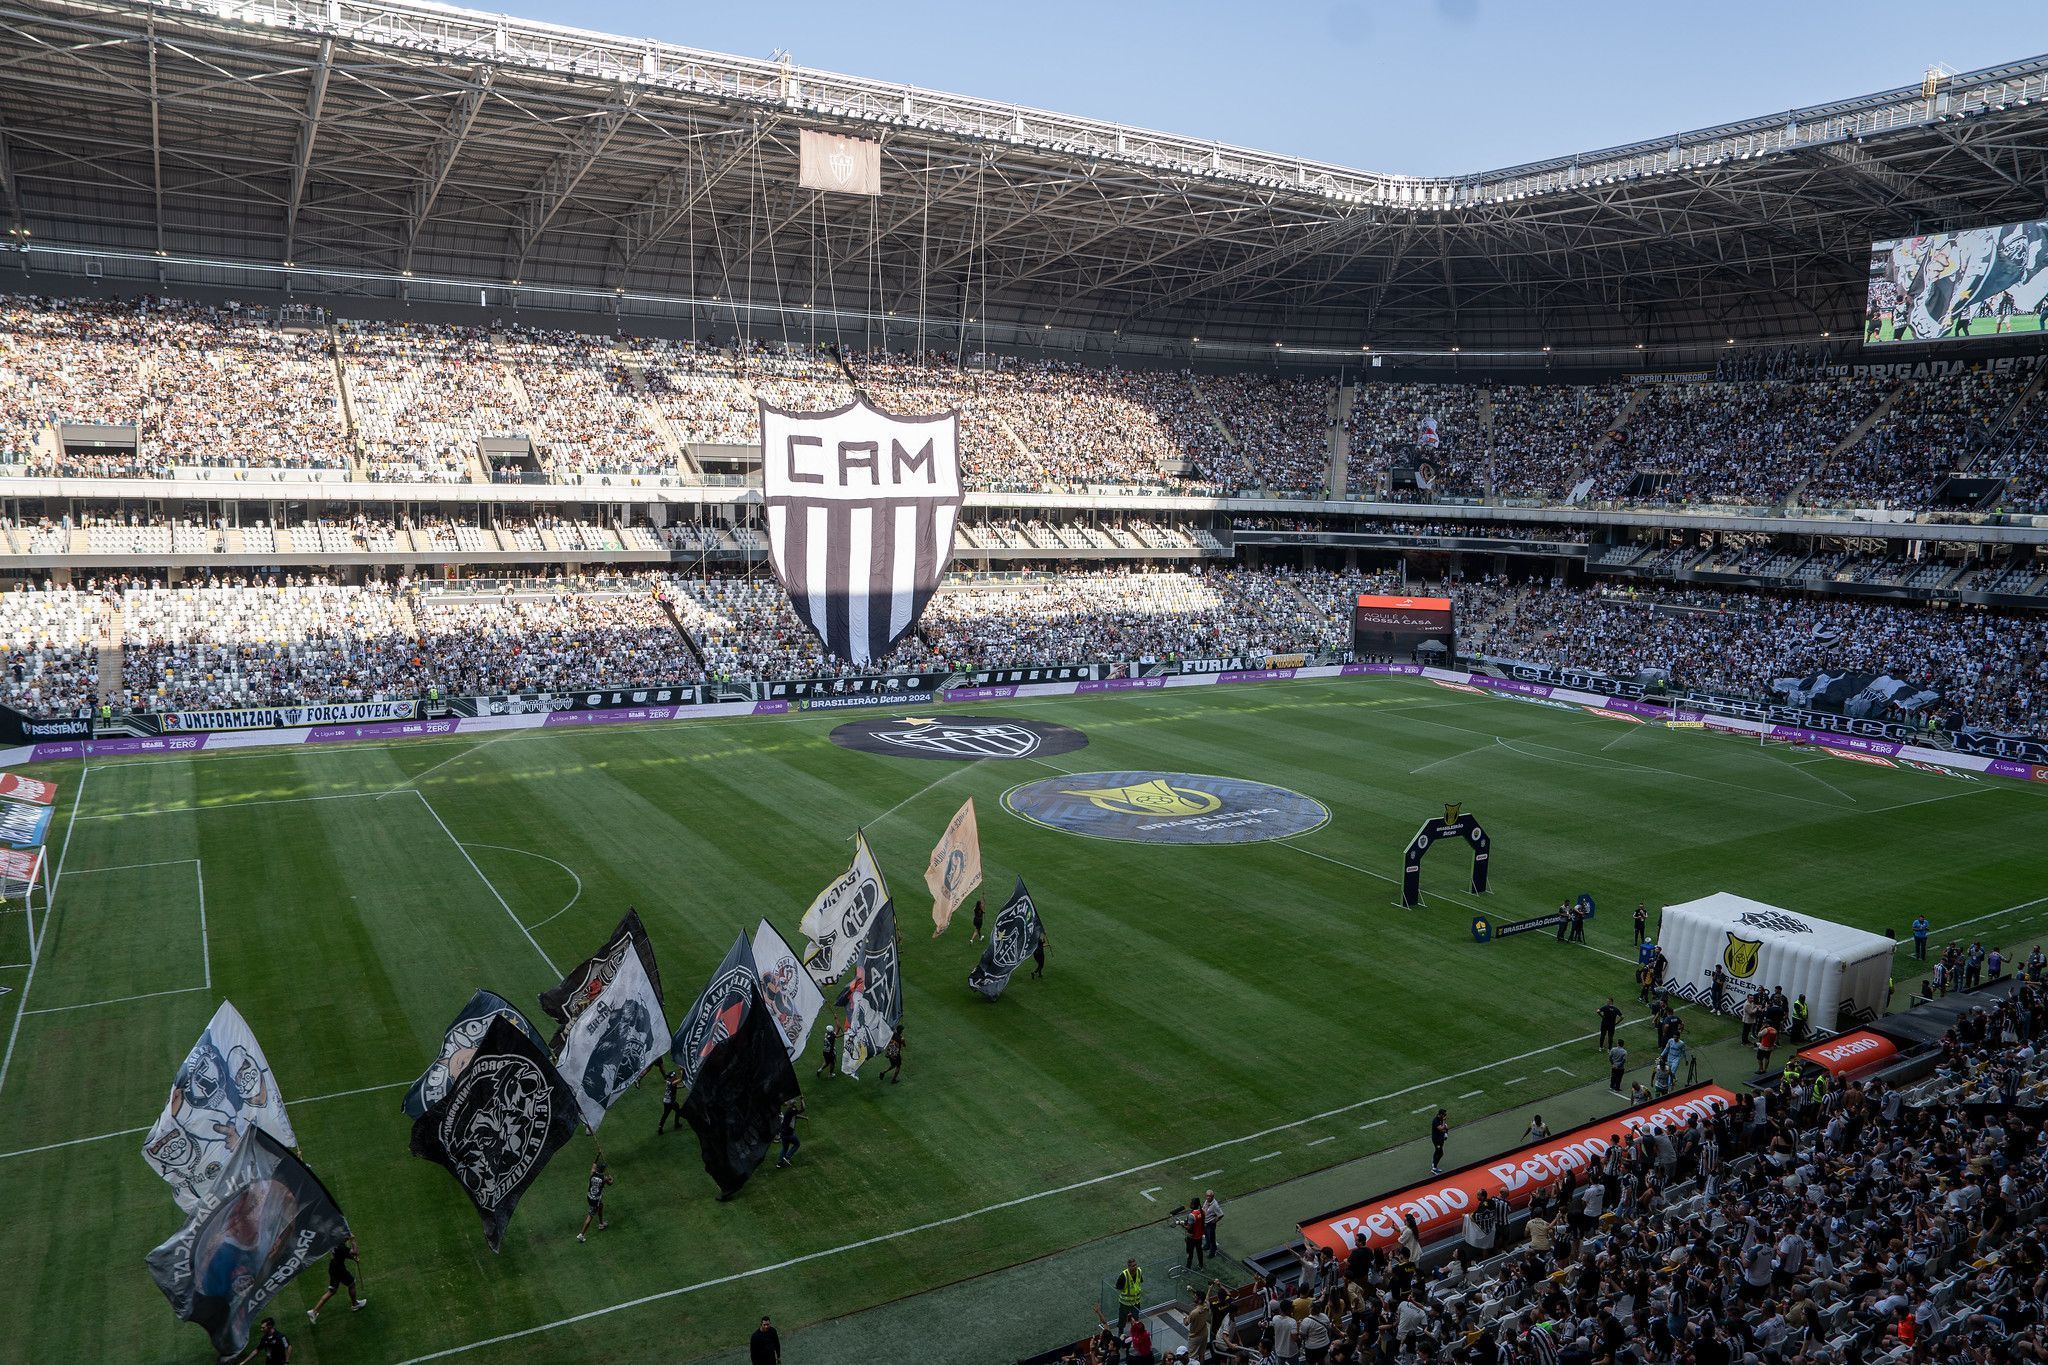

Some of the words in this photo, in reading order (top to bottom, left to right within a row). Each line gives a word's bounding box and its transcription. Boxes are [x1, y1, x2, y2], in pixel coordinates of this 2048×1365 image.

[1853, 359, 1966, 379] BRIGADA
[1664, 372, 1708, 383] ALVINEGRO
[787, 434, 937, 487] CAM
[1364, 617, 1401, 625] NOSSA
[1181, 657, 1242, 673] FURIA
[976, 667, 1090, 684] MINEIRO
[1513, 665, 1647, 698] CLUBE
[586, 688, 694, 706] CLUBE
[811, 696, 878, 709] BRASILEIRÃO
[879, 694, 907, 704] Betano
[908, 693, 931, 702] 2024
[183, 708, 282, 729] UNIFORMIZADA
[307, 704, 348, 722] FORÇA
[350, 702, 392, 719] JOVEM
[649, 711, 670, 719] ZERO
[320, 730, 335, 738] Ligue
[426, 724, 450, 733] ZERO
[902, 727, 1007, 740] CAM
[1781, 730, 1794, 738] Ligue
[43, 747, 61, 755] Ligue
[169, 739, 197, 749] ZERO
[1870, 744, 1893, 755] ZERO
[2000, 763, 2015, 773] Ligue
[1136, 807, 1280, 831] BRASILEIRÃO
[1503, 919, 1544, 934] BRASILEIRÃO
[1818, 1037, 1880, 1062] Betano
[1620, 1093, 1730, 1136] Betano
[1488, 1136, 1611, 1191] Betano
[1329, 1186, 1469, 1251] Betano
